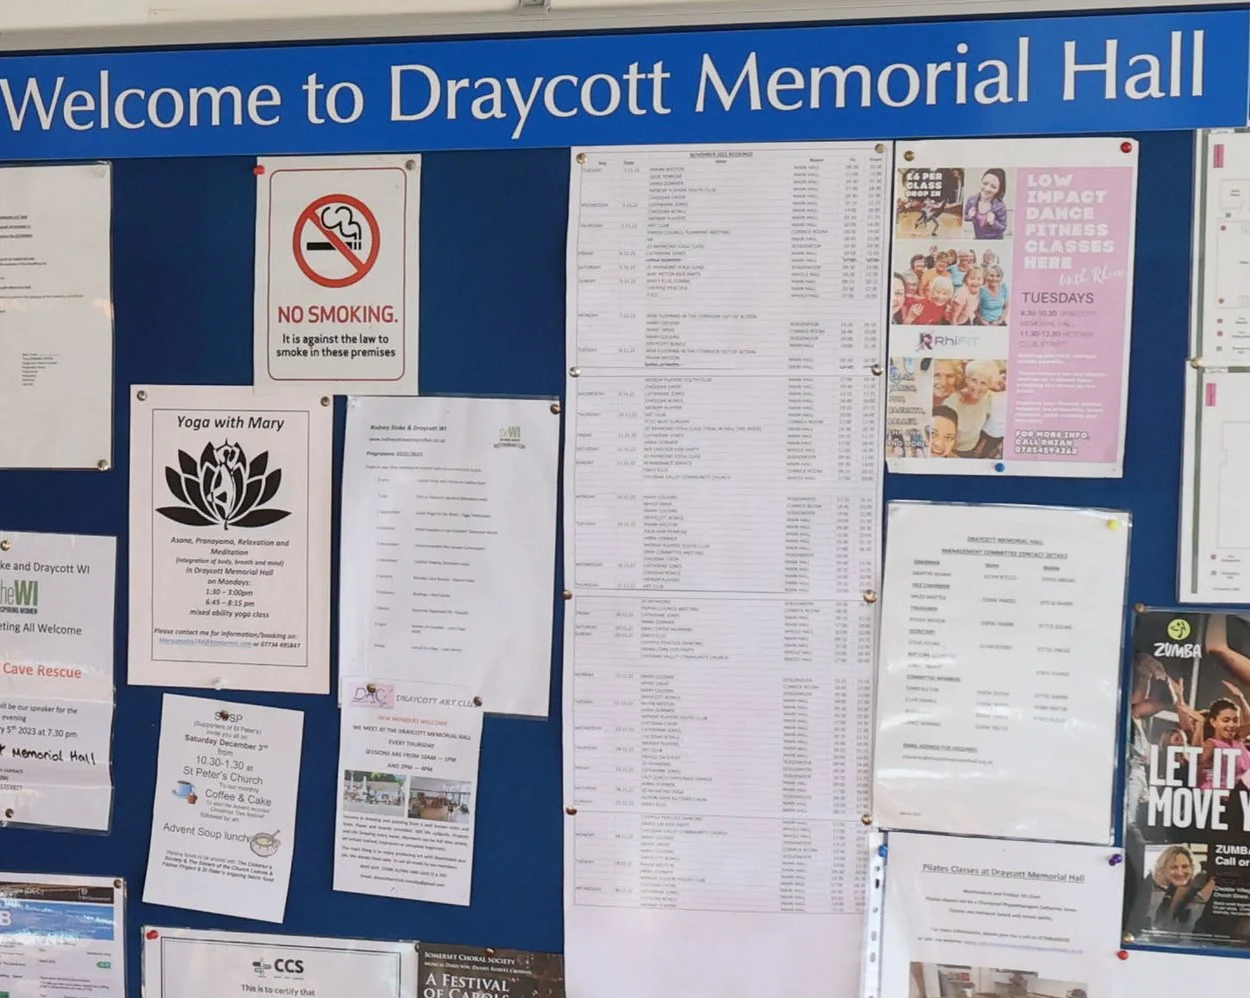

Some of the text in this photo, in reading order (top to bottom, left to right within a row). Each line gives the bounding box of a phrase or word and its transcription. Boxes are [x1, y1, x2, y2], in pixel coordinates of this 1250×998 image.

[303, 73, 365, 125] to
[389, 59, 672, 141] Draycott
[695, 35, 1030, 113] Memorial
[1063, 29, 1205, 101] Hall
[1027, 174, 1073, 187] LOW
[1027, 191, 1106, 203] IMPACT
[1026, 207, 1094, 219] DANCE
[1026, 224, 1109, 236] FITNESS
[1025, 241, 1115, 253] CLASSES
[1024, 257, 1072, 269] HERE
[1023, 292, 1094, 304] TUESDAYS
[278, 306, 398, 323] NO SMOKING.
[283, 333, 389, 346] It is against the law to
[277, 347, 395, 359] smoke in these premises
[177, 415, 284, 432] Yoga with Mary
[14, 562, 30, 571] and
[34, 563, 74, 574] Draycott
[77, 565, 90, 574] WI
[194, 568, 223, 576] Draycott
[212, 610, 233, 618] ability
[23, 622, 35, 632] All
[38, 623, 82, 636] Welcome
[1154, 642, 1202, 658] ZUMBA
[3, 662, 33, 675] Cave
[38, 665, 81, 678] Rescue
[396, 695, 438, 705] DRAYCOTT
[439, 698, 456, 706] ART
[214, 712, 243, 722] SSP
[6, 725, 16, 734] 5th
[18, 726, 36, 736] 2023
[38, 728, 46, 736] at
[48, 728, 66, 738] 7.30
[68, 730, 77, 739] pm
[185, 734, 217, 746] Saturday
[220, 740, 256, 750] December
[12, 748, 62, 762] Memorial
[70, 751, 96, 766] Hall
[197, 756, 244, 770] 10.30-1.30
[1150, 745, 1241, 789] LET IT
[184, 766, 263, 785] St Peter's Church
[205, 789, 272, 806] Coffee & Cake
[1148, 786, 1230, 830] MOVE
[163, 823, 250, 843] Advent Soup lunch
[1215, 856, 1235, 867] Call
[922, 864, 1085, 883] Pilates Classes at Draycott Memorial Hall
[0, 911, 11, 926] B
[274, 959, 304, 974] CCS
[426, 973, 509, 991] A FESTIVAL
[241, 984, 315, 997] This is to certify that
